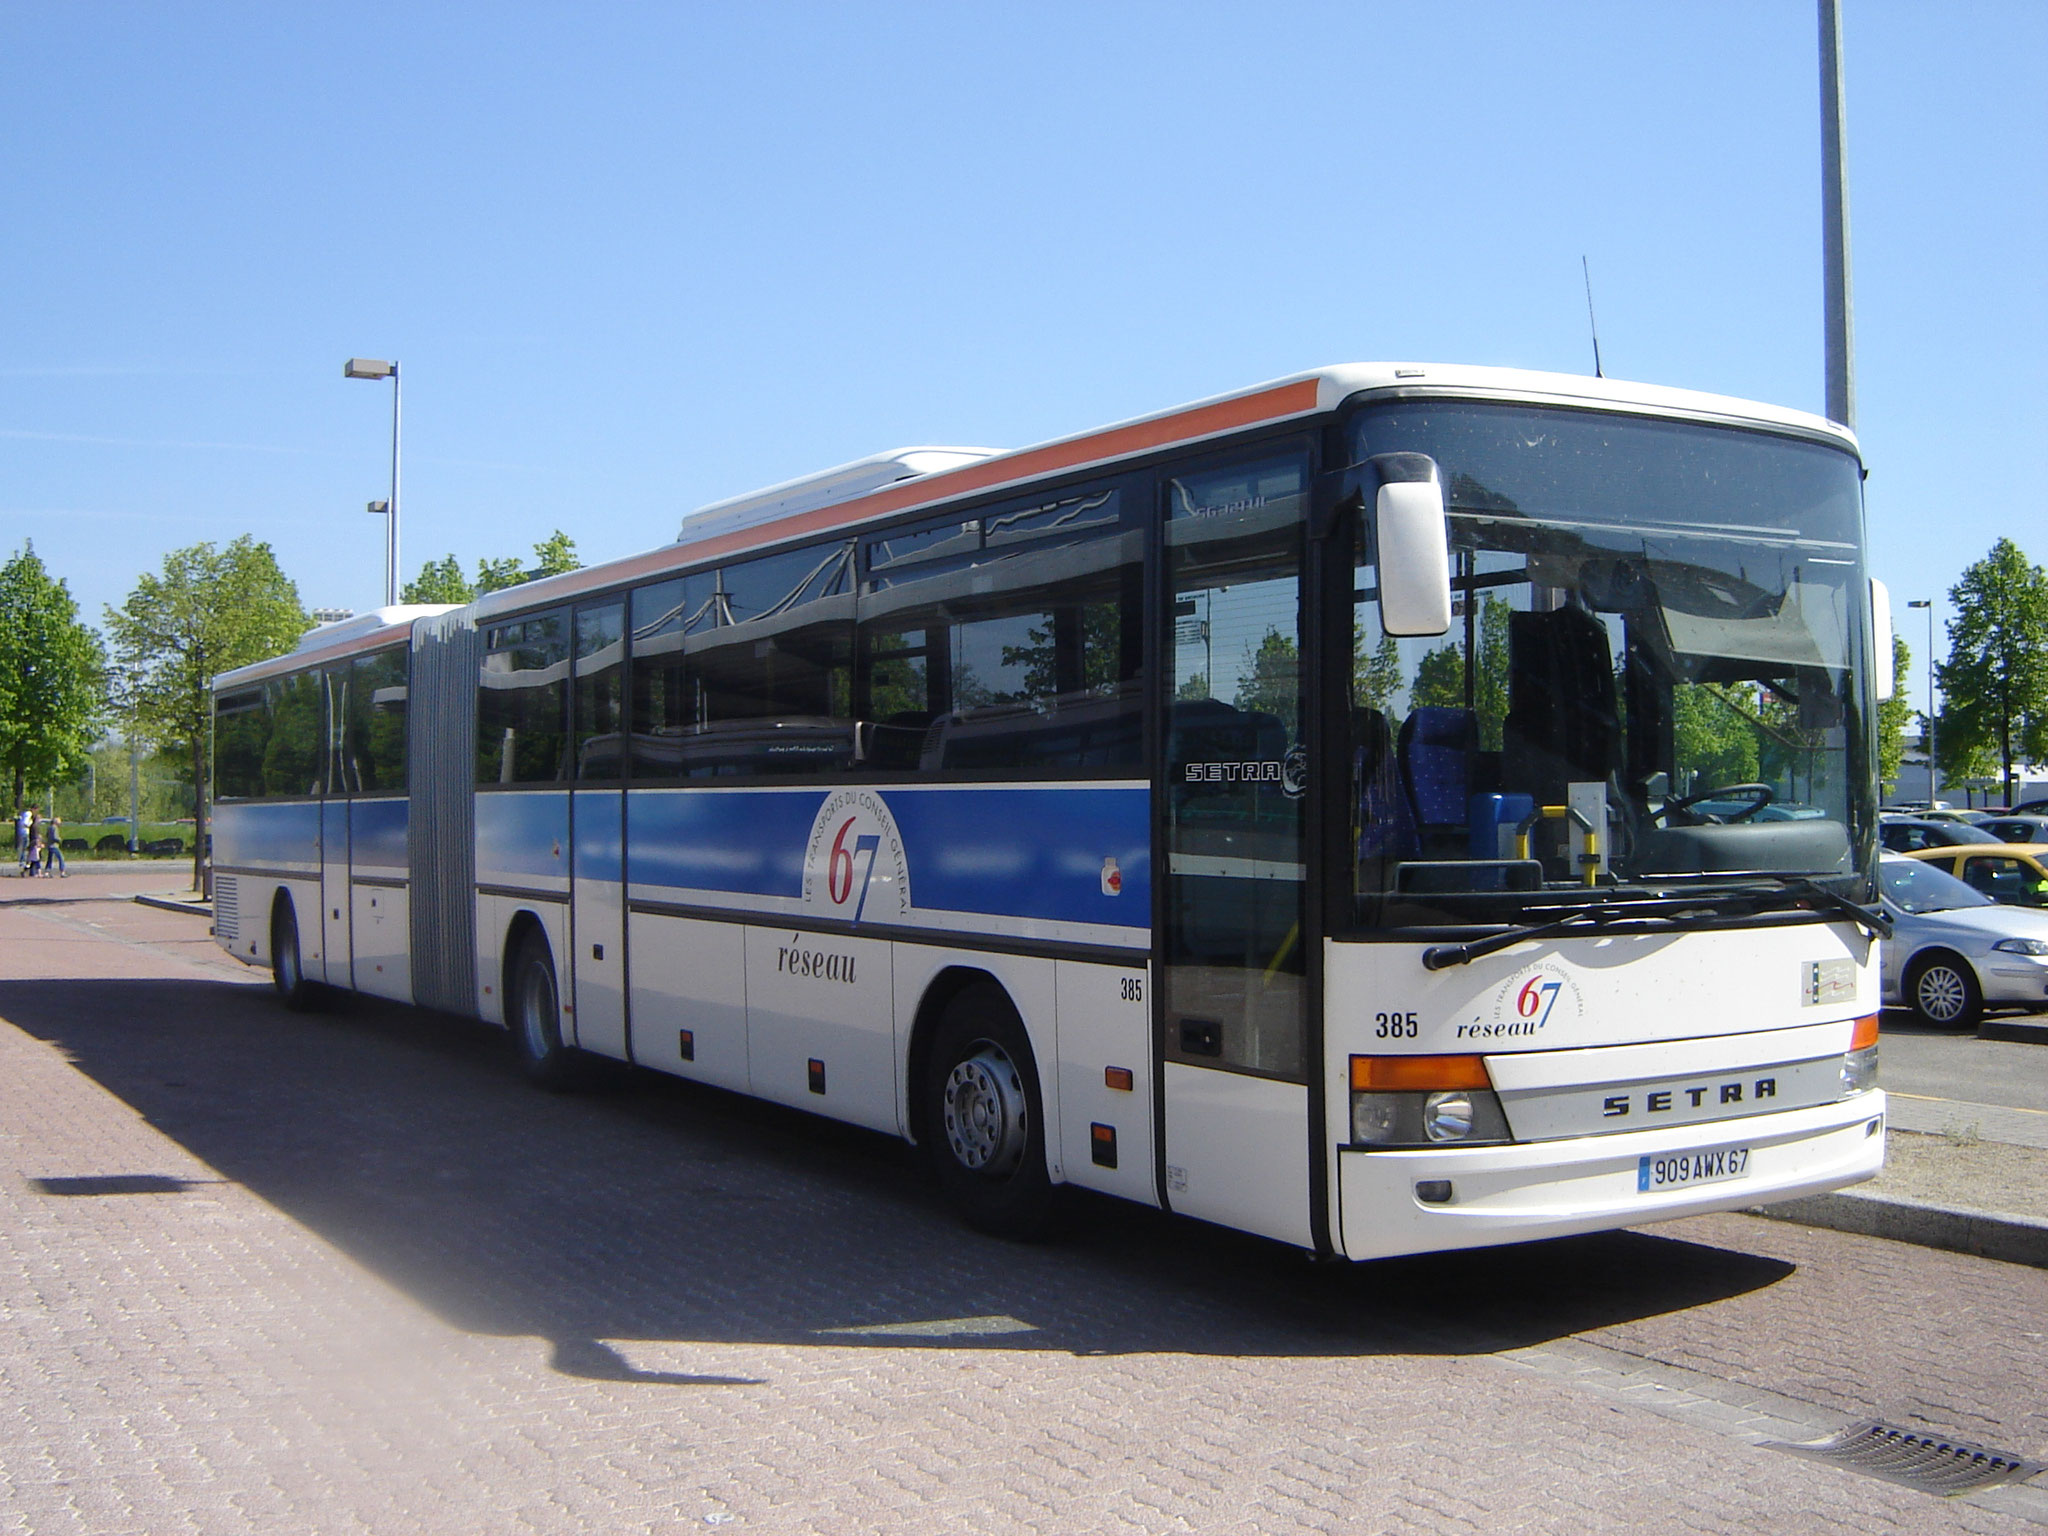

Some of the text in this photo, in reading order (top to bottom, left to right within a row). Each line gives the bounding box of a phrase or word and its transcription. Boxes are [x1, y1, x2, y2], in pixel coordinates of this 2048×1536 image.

[1185, 761, 1282, 782] SETRA
[845, 790, 857, 806] DU
[859, 792, 892, 838] CONSEIL
[807, 795, 845, 870] TRANSPORTS
[828, 815, 881, 924] 67
[804, 877, 813, 903] LES
[777, 932, 857, 984] réseau
[1120, 977, 1143, 1002] 385
[1516, 974, 1563, 1029] 67
[1375, 1012, 1418, 1039] 385
[1456, 1016, 1536, 1039] réseau
[1602, 1078, 1777, 1117] SETRA
[1654, 1147, 1749, 1185] 909 AWX 67
